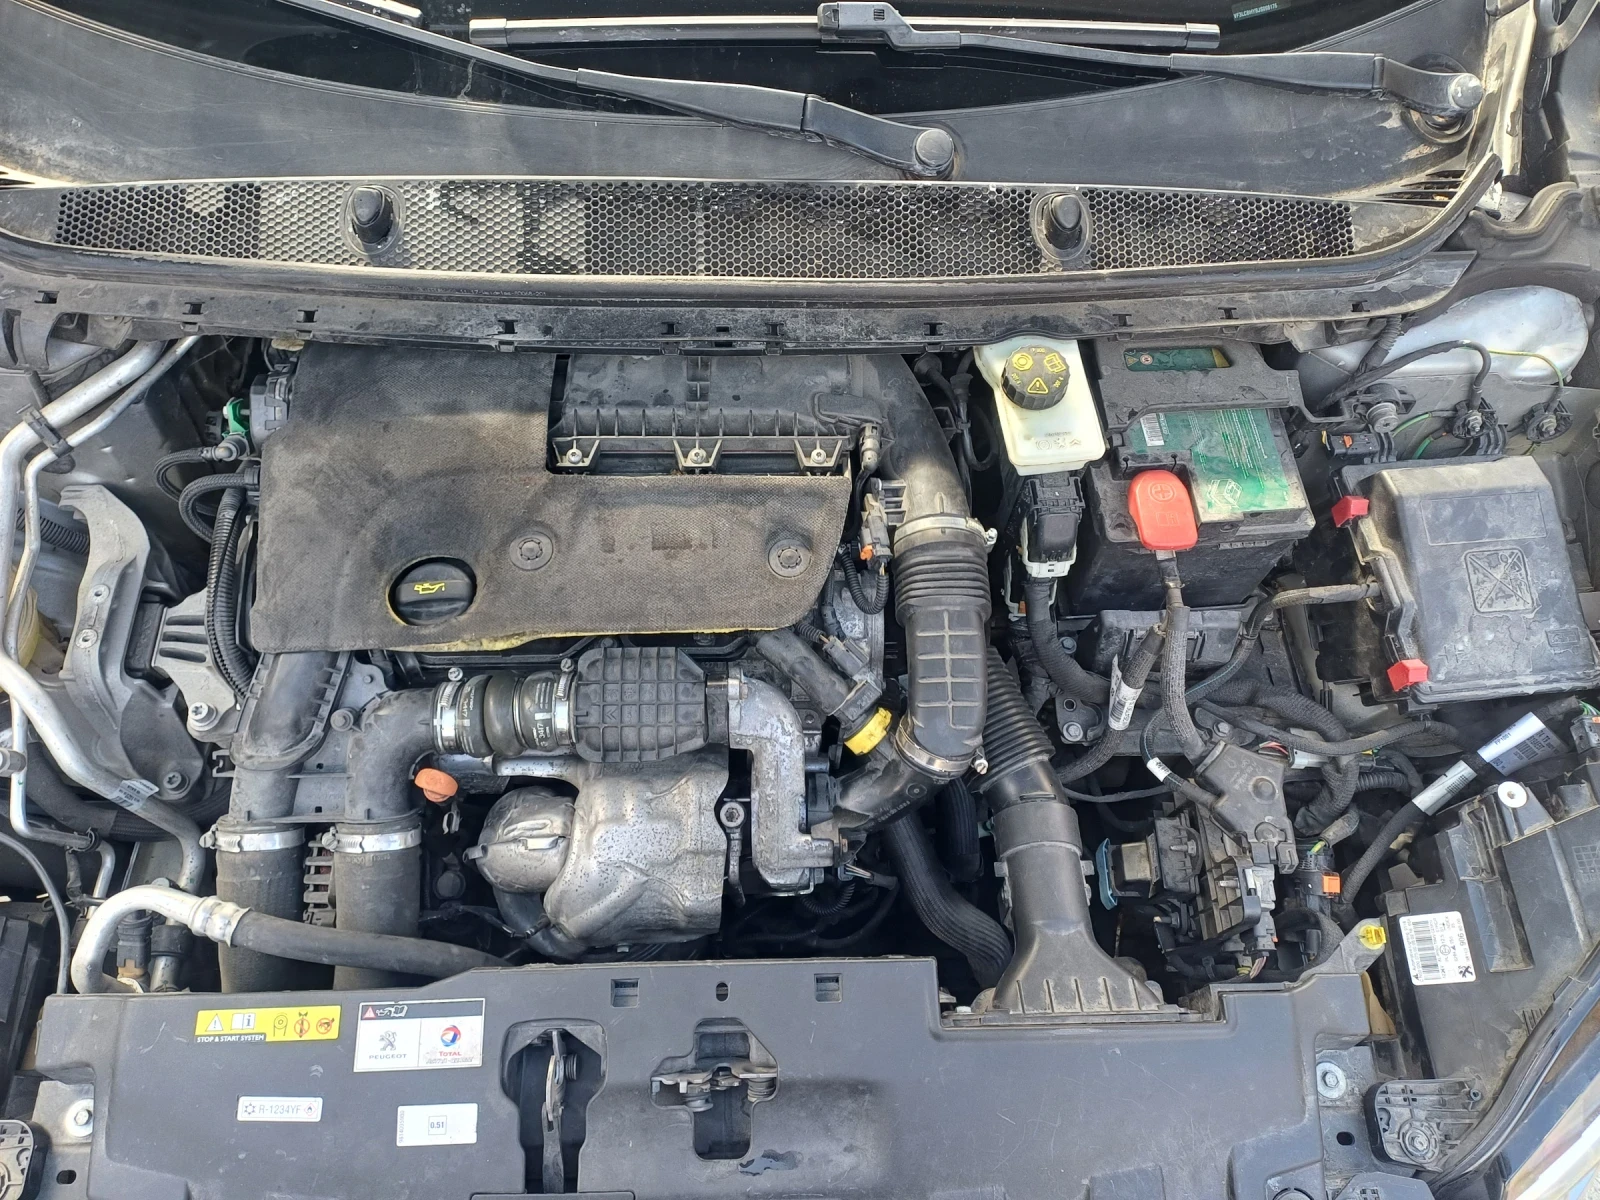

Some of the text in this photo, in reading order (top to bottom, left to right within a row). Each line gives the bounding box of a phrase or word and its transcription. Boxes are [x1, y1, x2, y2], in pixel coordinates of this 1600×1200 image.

[1457, 933, 1467, 947] 906
[258, 1104, 302, 1115] R-1234YF
[430, 1121, 445, 1129] 0.51
